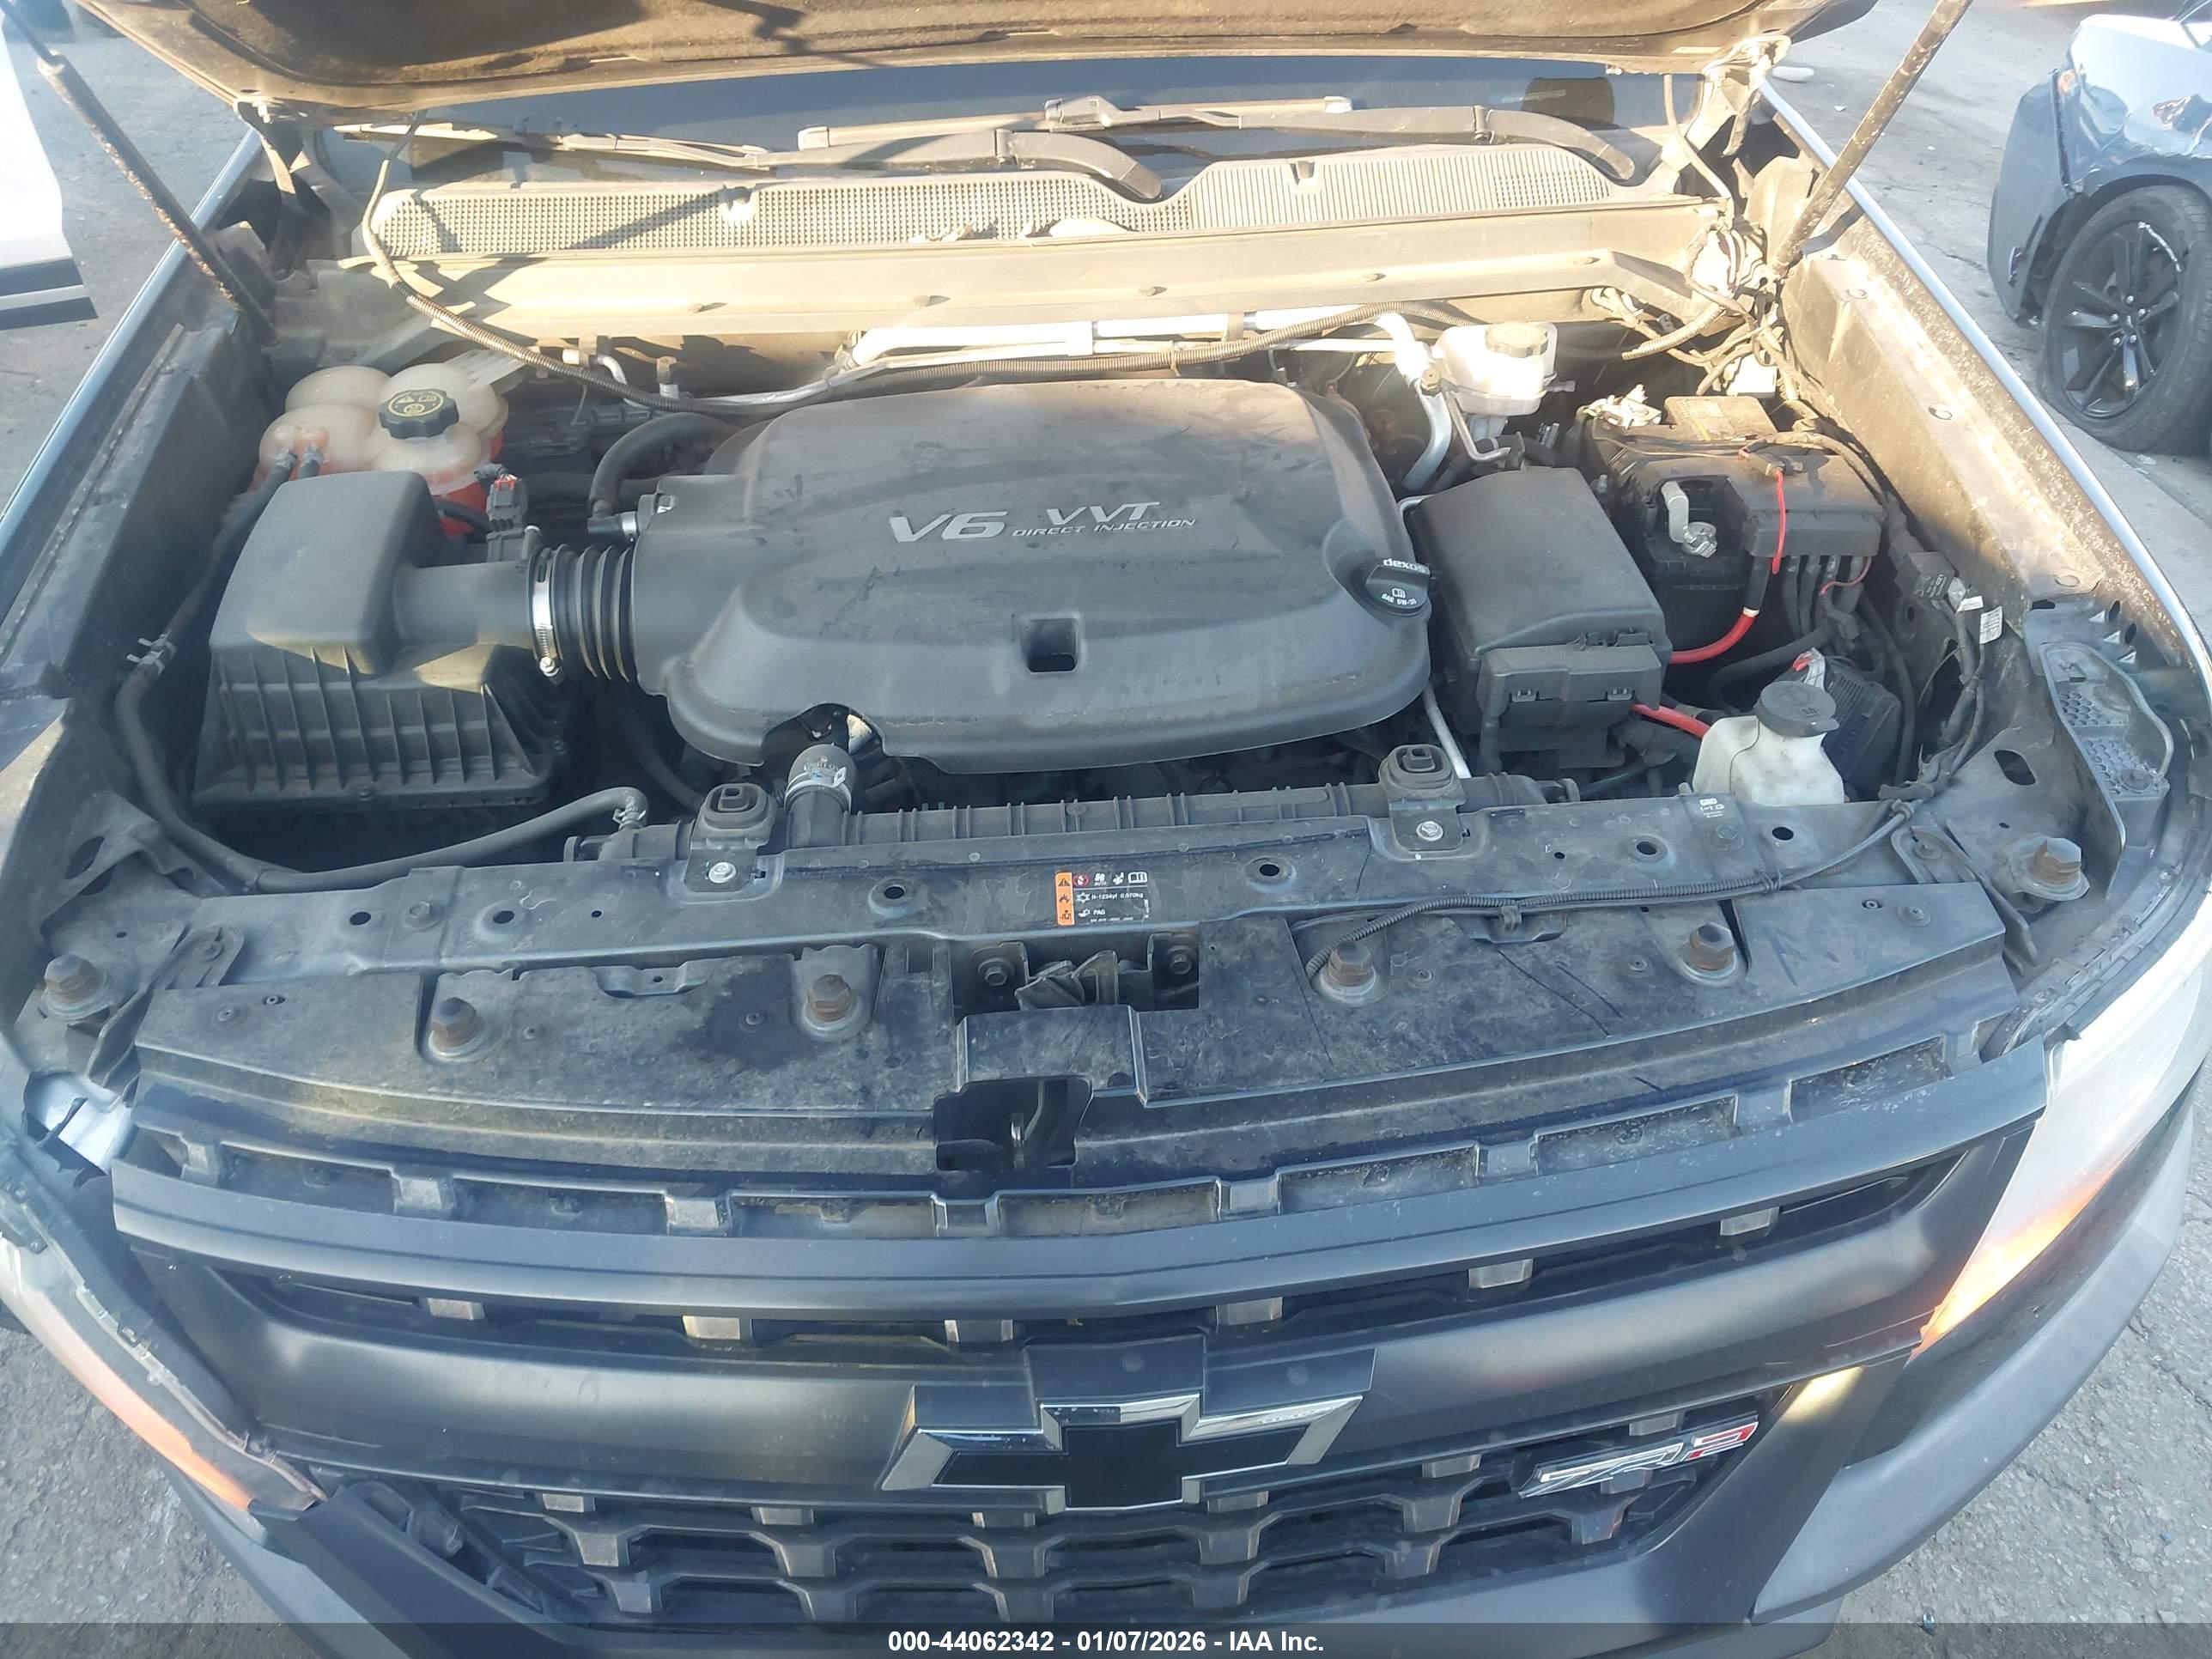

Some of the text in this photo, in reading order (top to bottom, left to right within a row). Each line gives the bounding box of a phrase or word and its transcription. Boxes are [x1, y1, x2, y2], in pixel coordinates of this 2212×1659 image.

[889, 501, 1160, 543] V6 VVT
[1012, 519, 1197, 538] DIRECT INJECTION
[1518, 1421, 1759, 1498] ZR2
